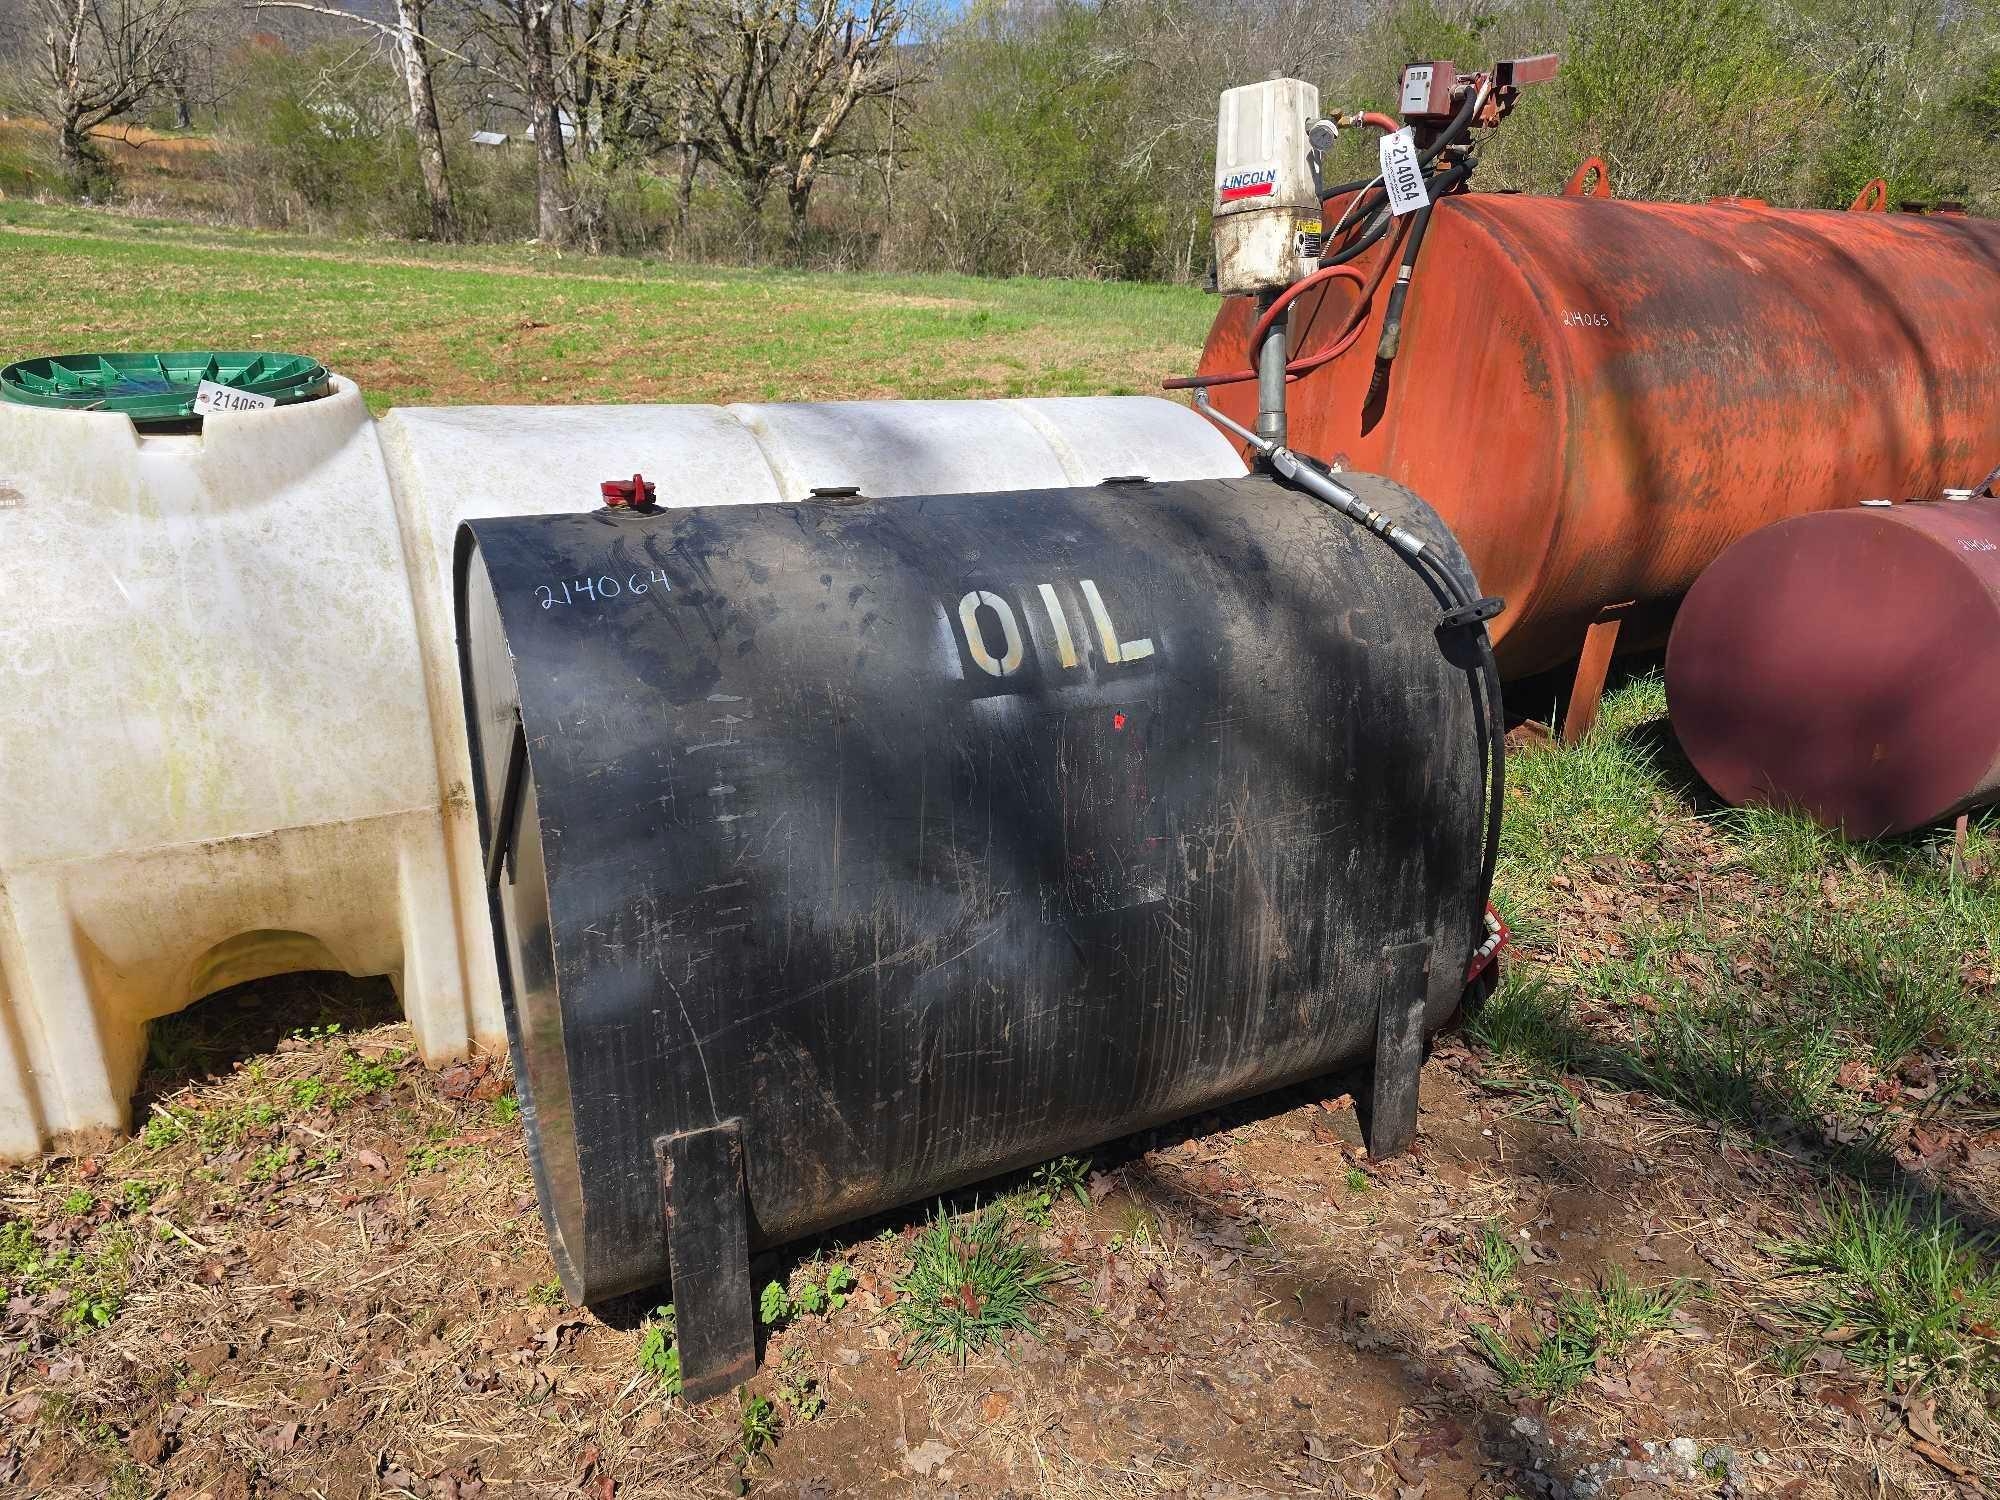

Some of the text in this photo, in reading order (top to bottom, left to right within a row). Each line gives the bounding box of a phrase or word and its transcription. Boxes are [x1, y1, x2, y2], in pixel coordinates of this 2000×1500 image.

[1223, 170, 1276, 189] LINCOLN
[1393, 145, 1419, 201] 214064
[1560, 309, 1609, 327] 214065
[534, 569, 672, 610] 214064
[958, 579, 1155, 677] OIL
